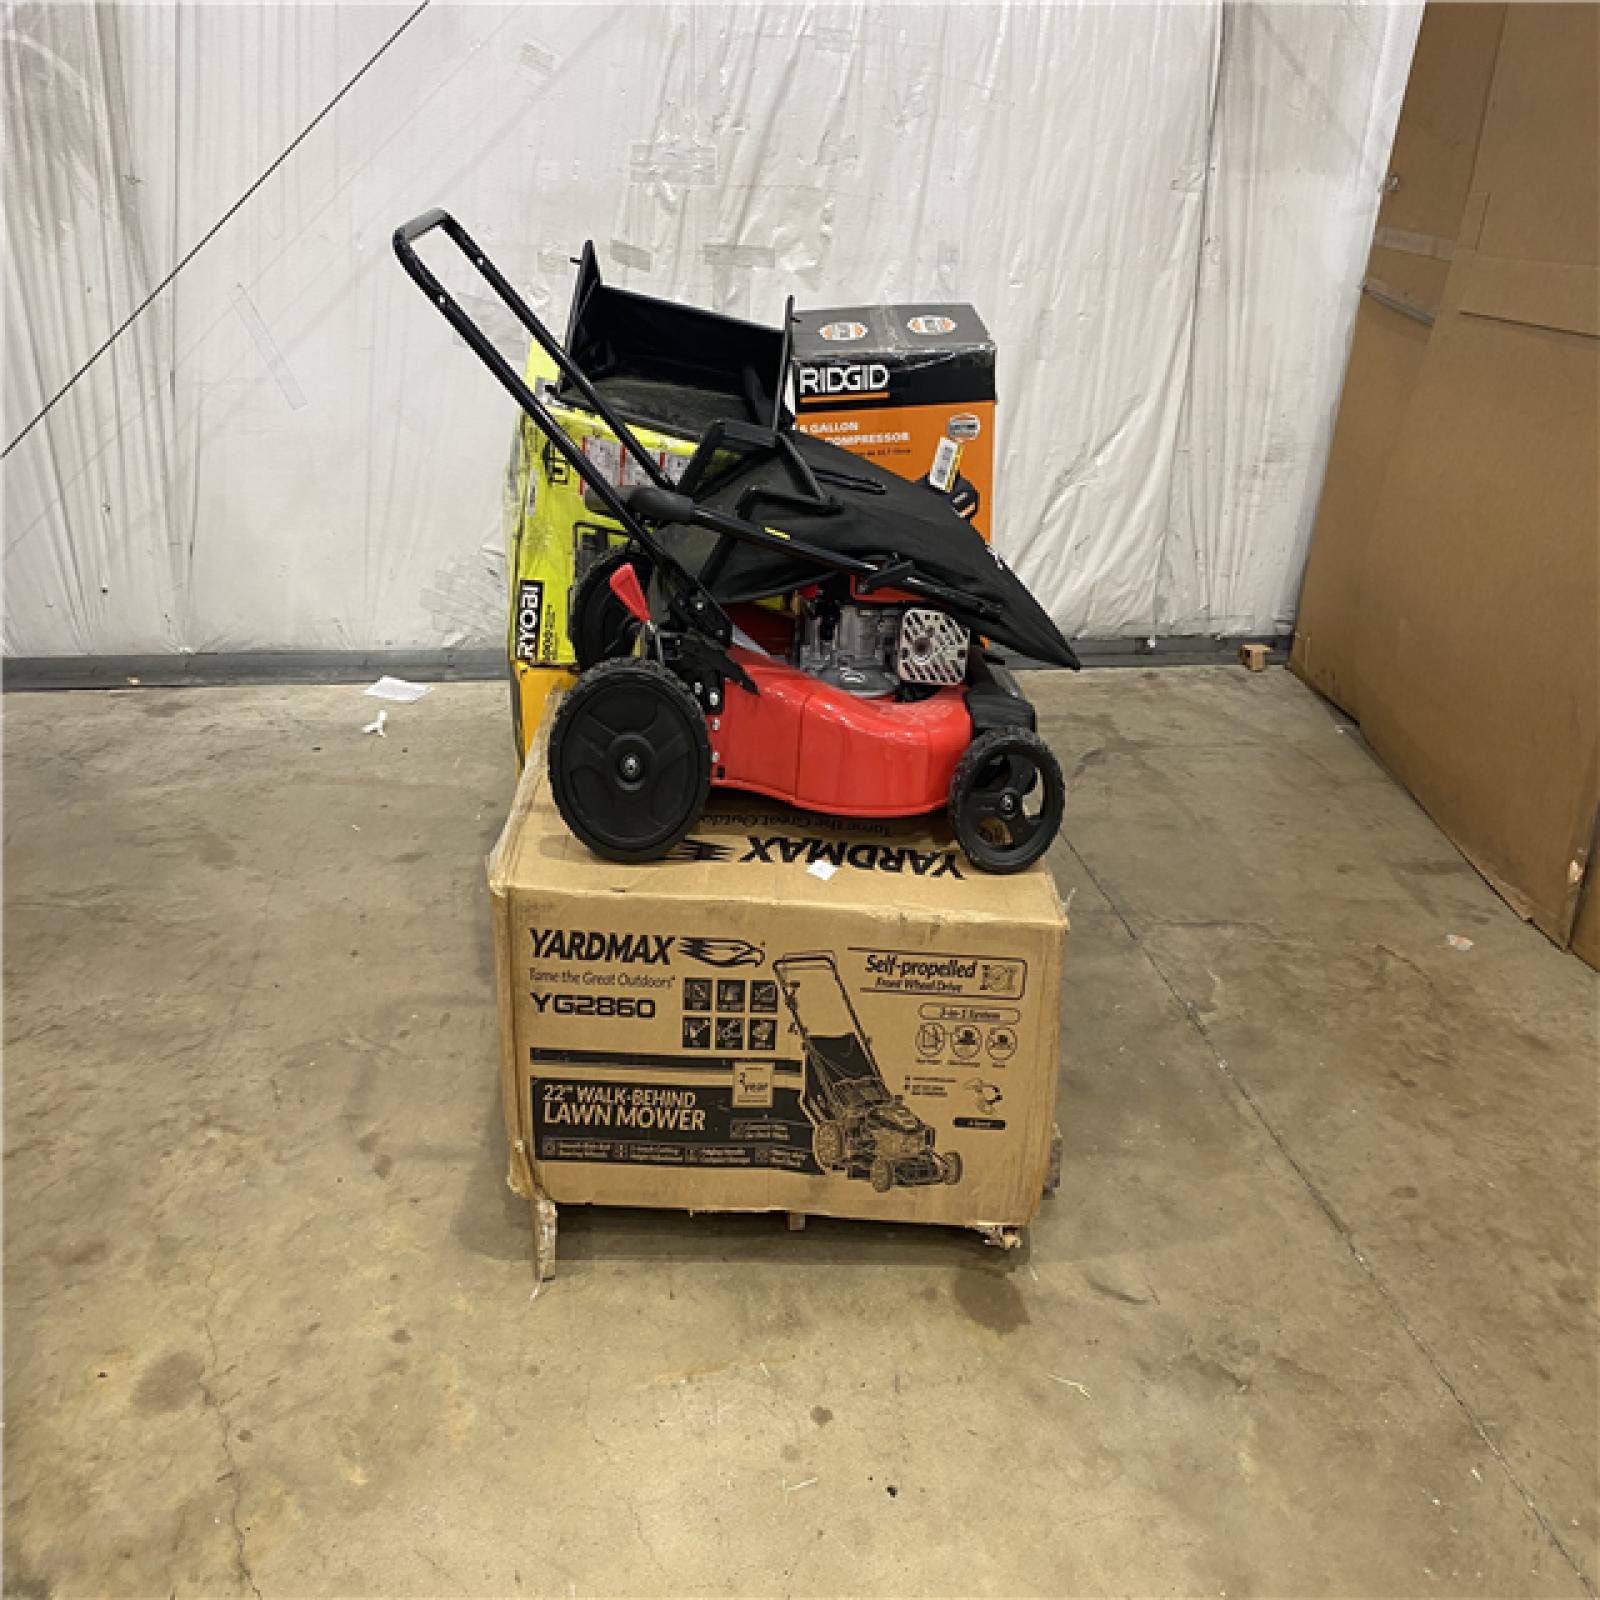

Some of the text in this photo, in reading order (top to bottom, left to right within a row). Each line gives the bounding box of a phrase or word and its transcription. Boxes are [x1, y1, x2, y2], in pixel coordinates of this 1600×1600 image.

[800, 364, 890, 394] RIDGID
[810, 421, 859, 433] GALLON
[517, 584, 539, 658] RYOBI
[738, 835, 966, 880] YARDMAX
[528, 928, 676, 966] YARDMAX
[582, 970, 616, 986] Great
[865, 954, 978, 980] Self-propelled
[529, 991, 656, 1018] YG2860
[576, 1085, 696, 1108] WALK-BEHIND
[543, 1101, 612, 1126] LAWN
[615, 1106, 706, 1131] MOWER
